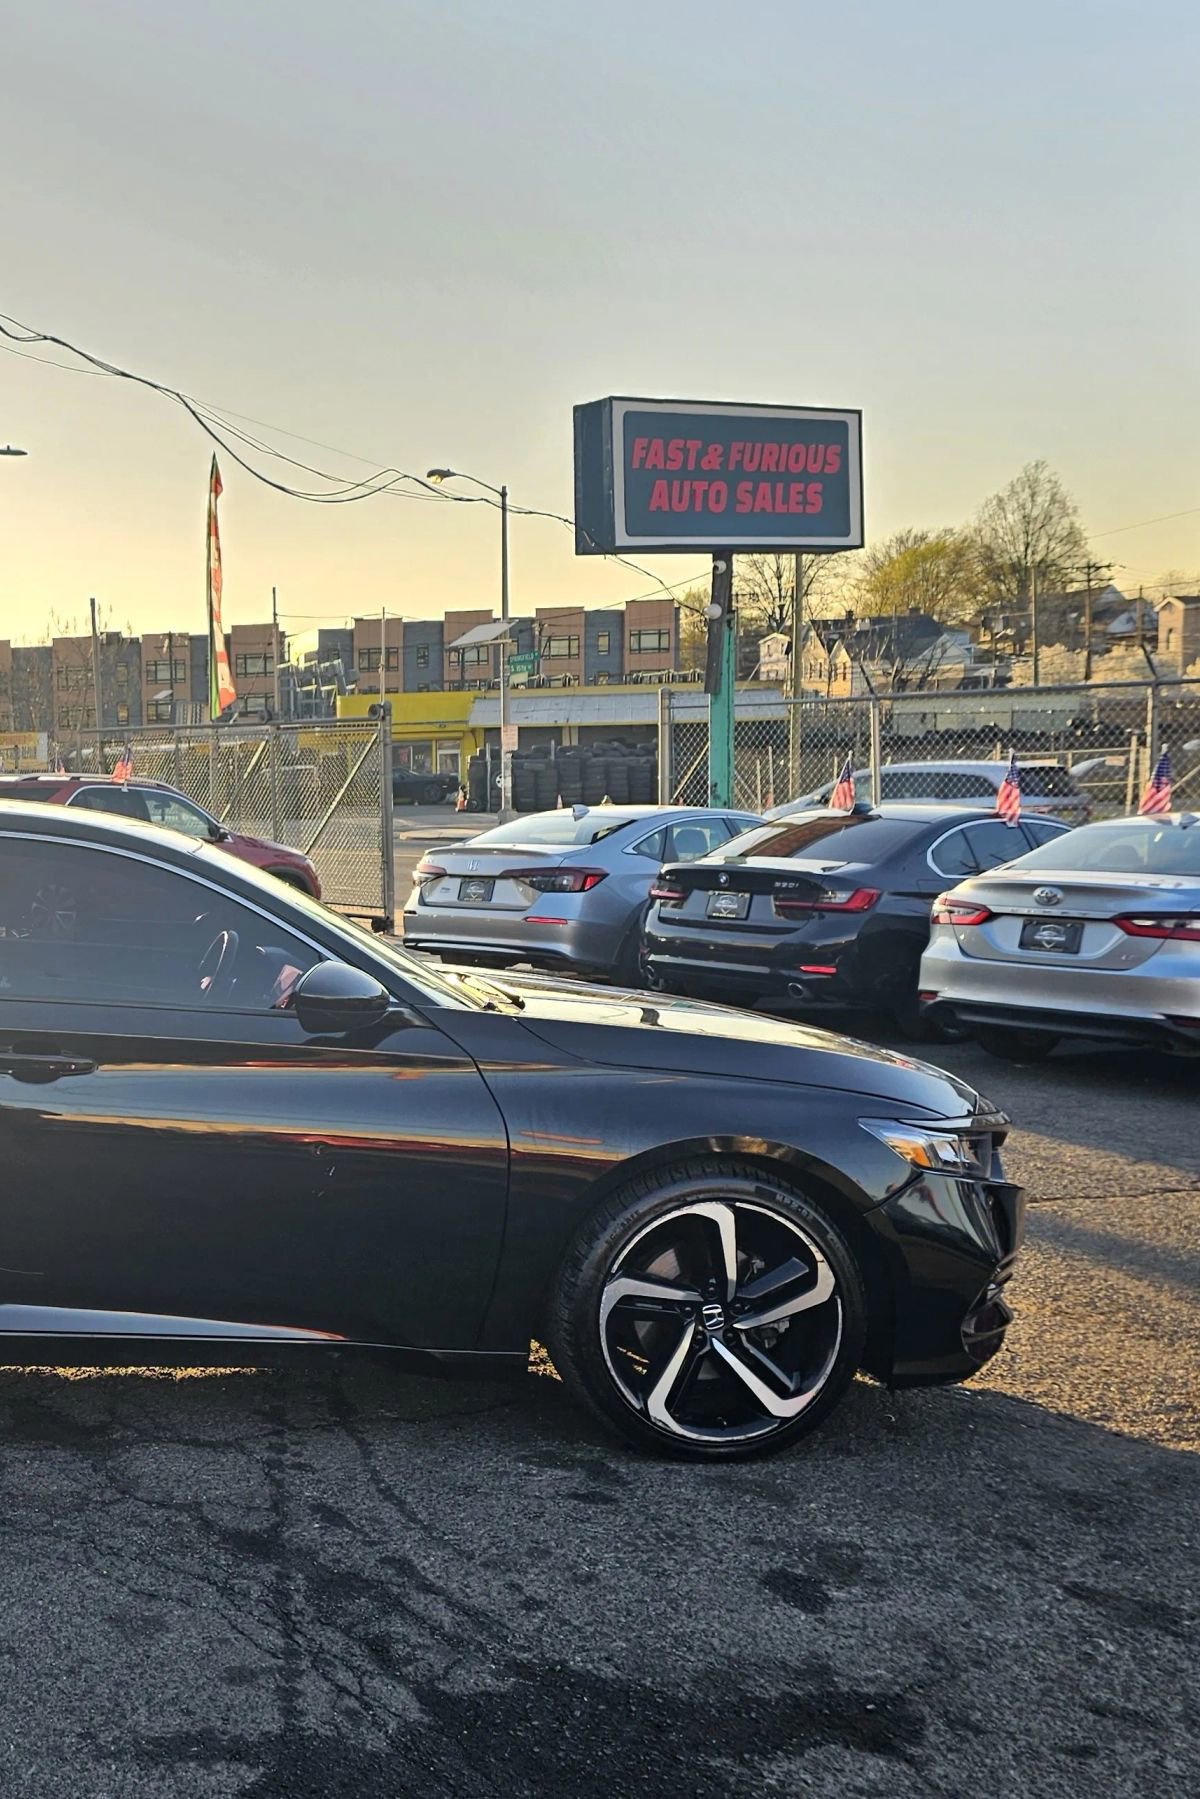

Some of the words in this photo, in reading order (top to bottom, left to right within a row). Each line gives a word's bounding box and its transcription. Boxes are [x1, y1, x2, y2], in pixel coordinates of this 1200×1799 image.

[632, 437, 702, 471] FAST
[728, 441, 842, 474] FURIOUS
[648, 479, 728, 513] AUTO
[735, 481, 824, 514] SALES
